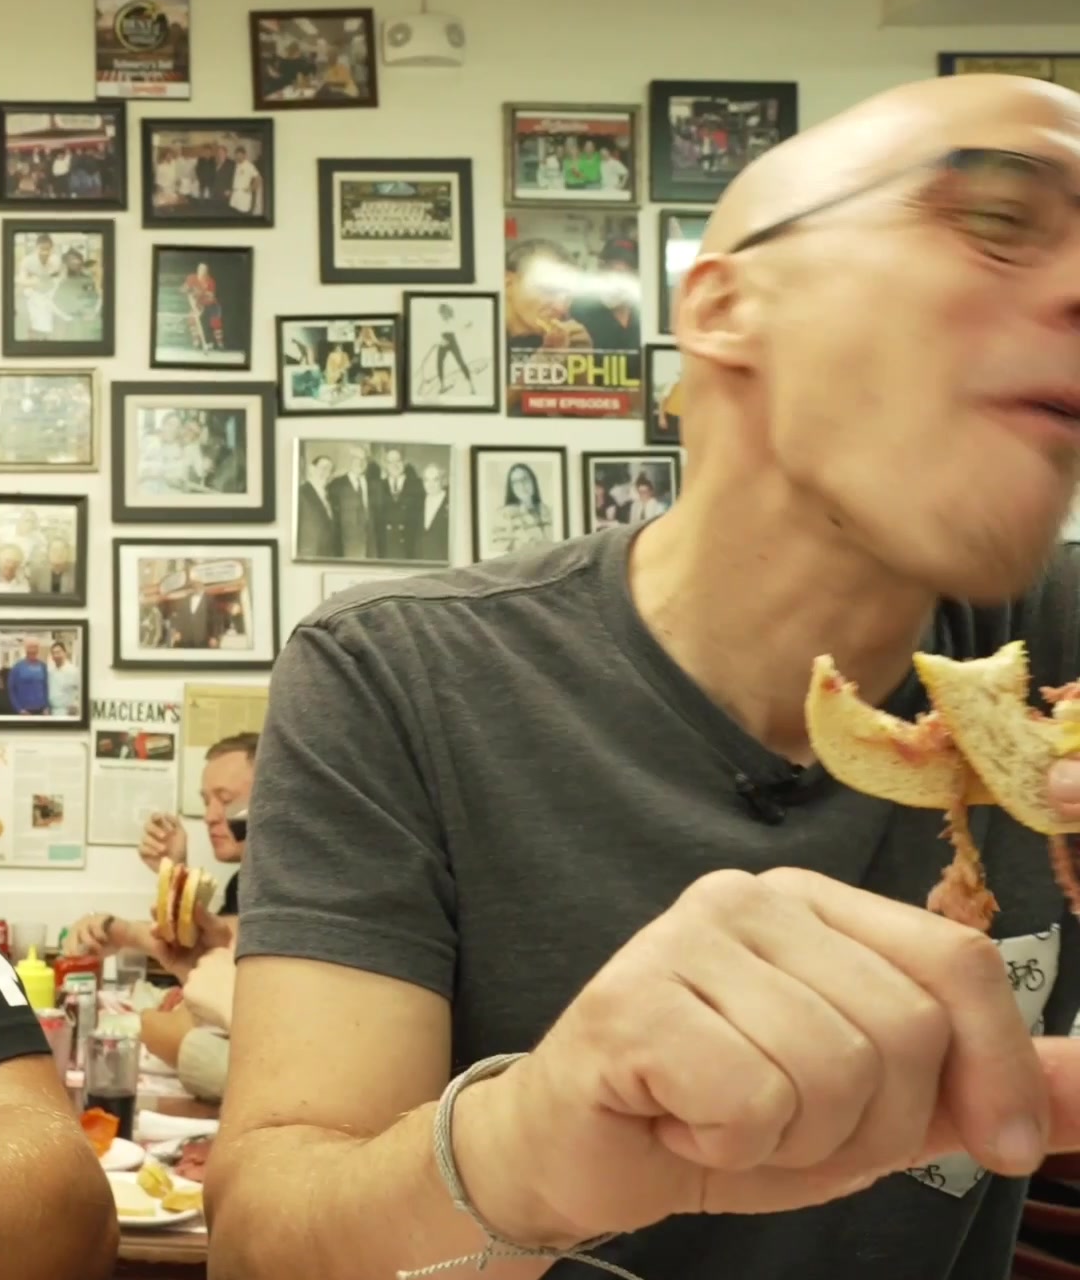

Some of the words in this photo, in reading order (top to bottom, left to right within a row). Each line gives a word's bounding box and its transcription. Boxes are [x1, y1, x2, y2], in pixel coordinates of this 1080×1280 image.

[510, 363, 567, 385] FEED
[567, 353, 641, 387] PHIL
[528, 396, 558, 408] NEW
[559, 397, 621, 410] EPISODES
[91, 699, 182, 724] MACLEAN'S
